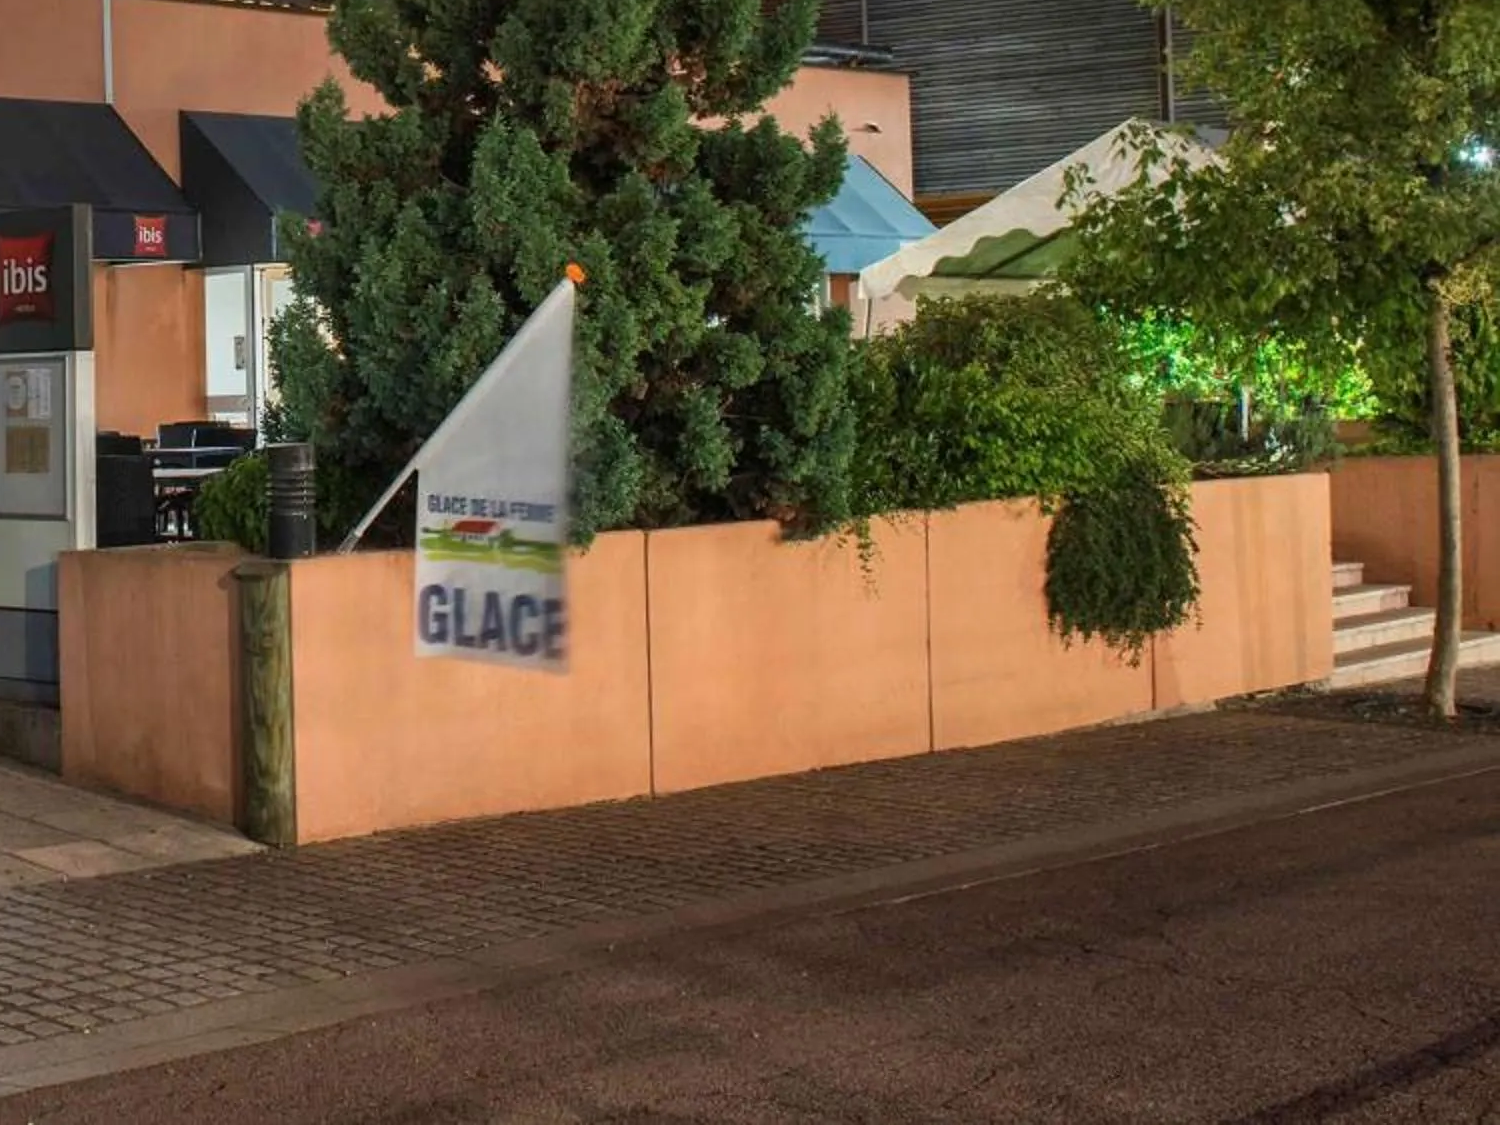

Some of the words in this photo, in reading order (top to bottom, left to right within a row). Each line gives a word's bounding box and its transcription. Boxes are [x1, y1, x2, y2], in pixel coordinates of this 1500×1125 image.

[138, 225, 162, 244] ibis
[3, 257, 47, 295] ibis
[427, 494, 466, 515] GLACE
[419, 584, 567, 660] GLACE
